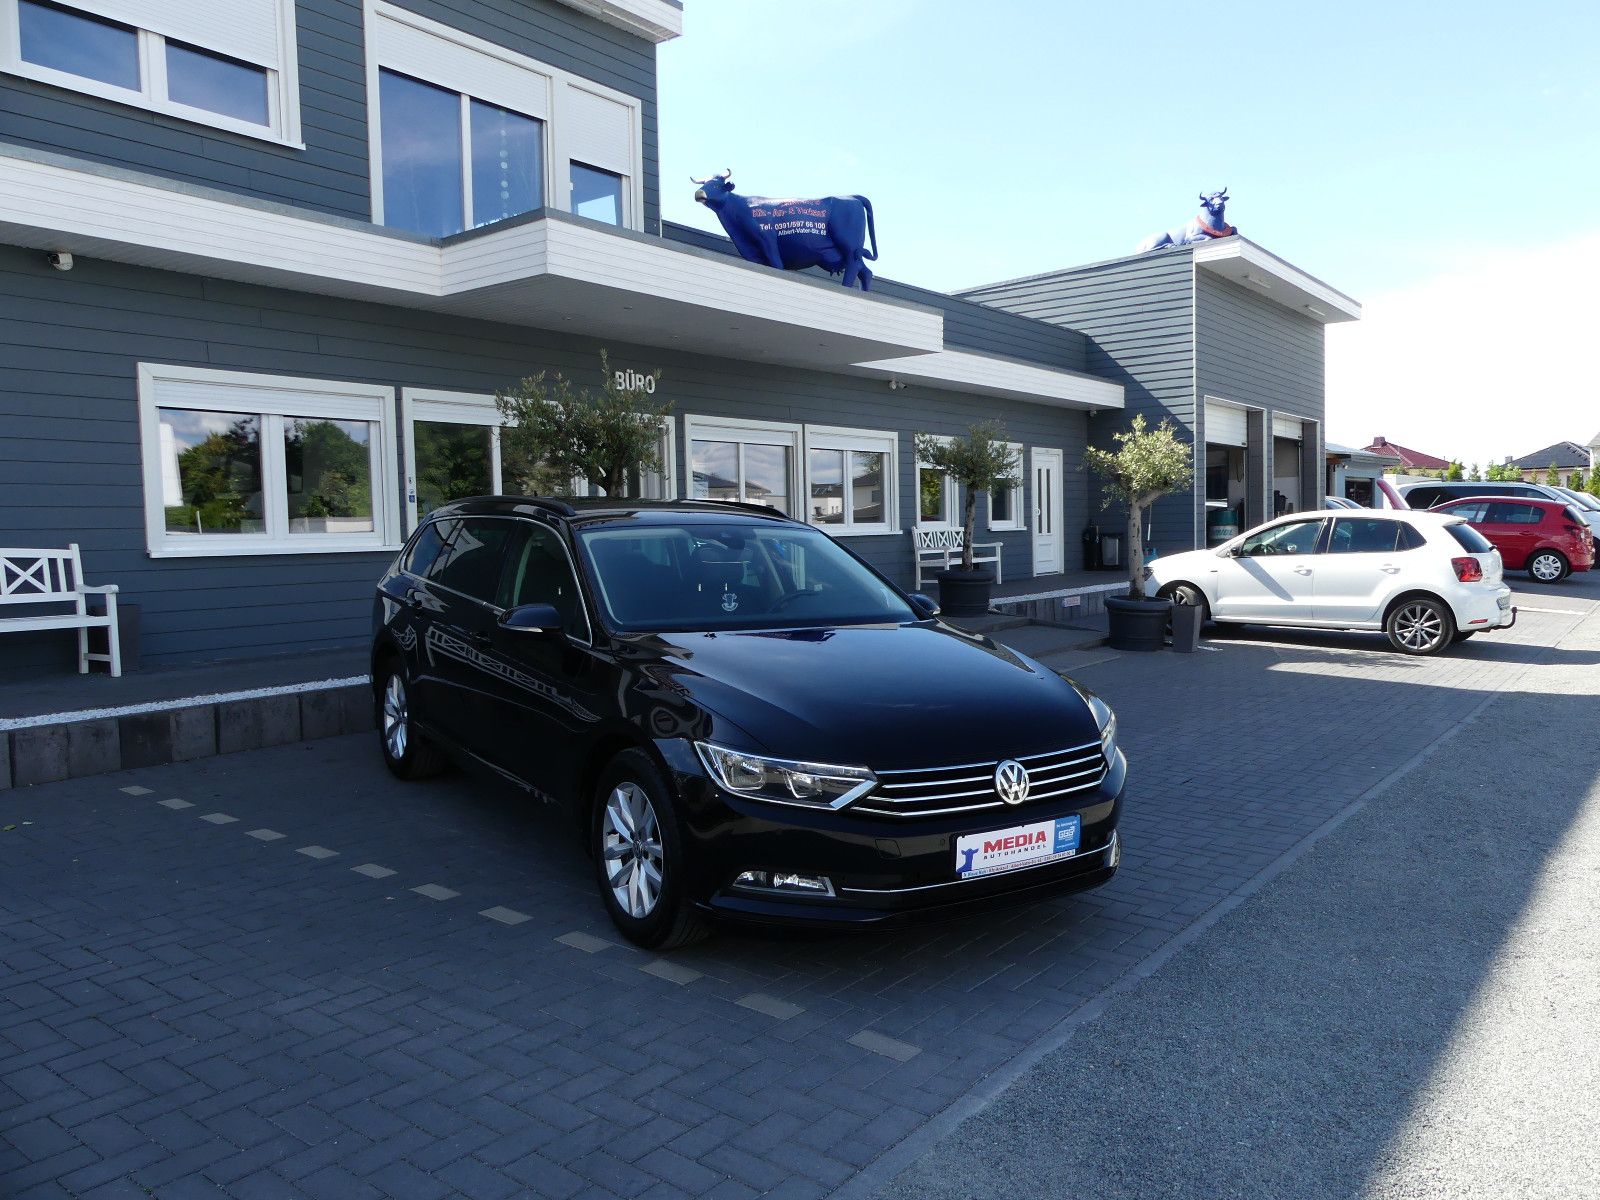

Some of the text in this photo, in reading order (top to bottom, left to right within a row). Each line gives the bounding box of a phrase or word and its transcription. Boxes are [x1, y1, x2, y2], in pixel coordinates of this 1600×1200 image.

[760, 223, 773, 231] Tel.
[815, 222, 826, 230] 100
[615, 369, 655, 393] BÜRO
[983, 831, 1046, 853] MEDIA
[983, 844, 1047, 861] AUTOHANDEL
